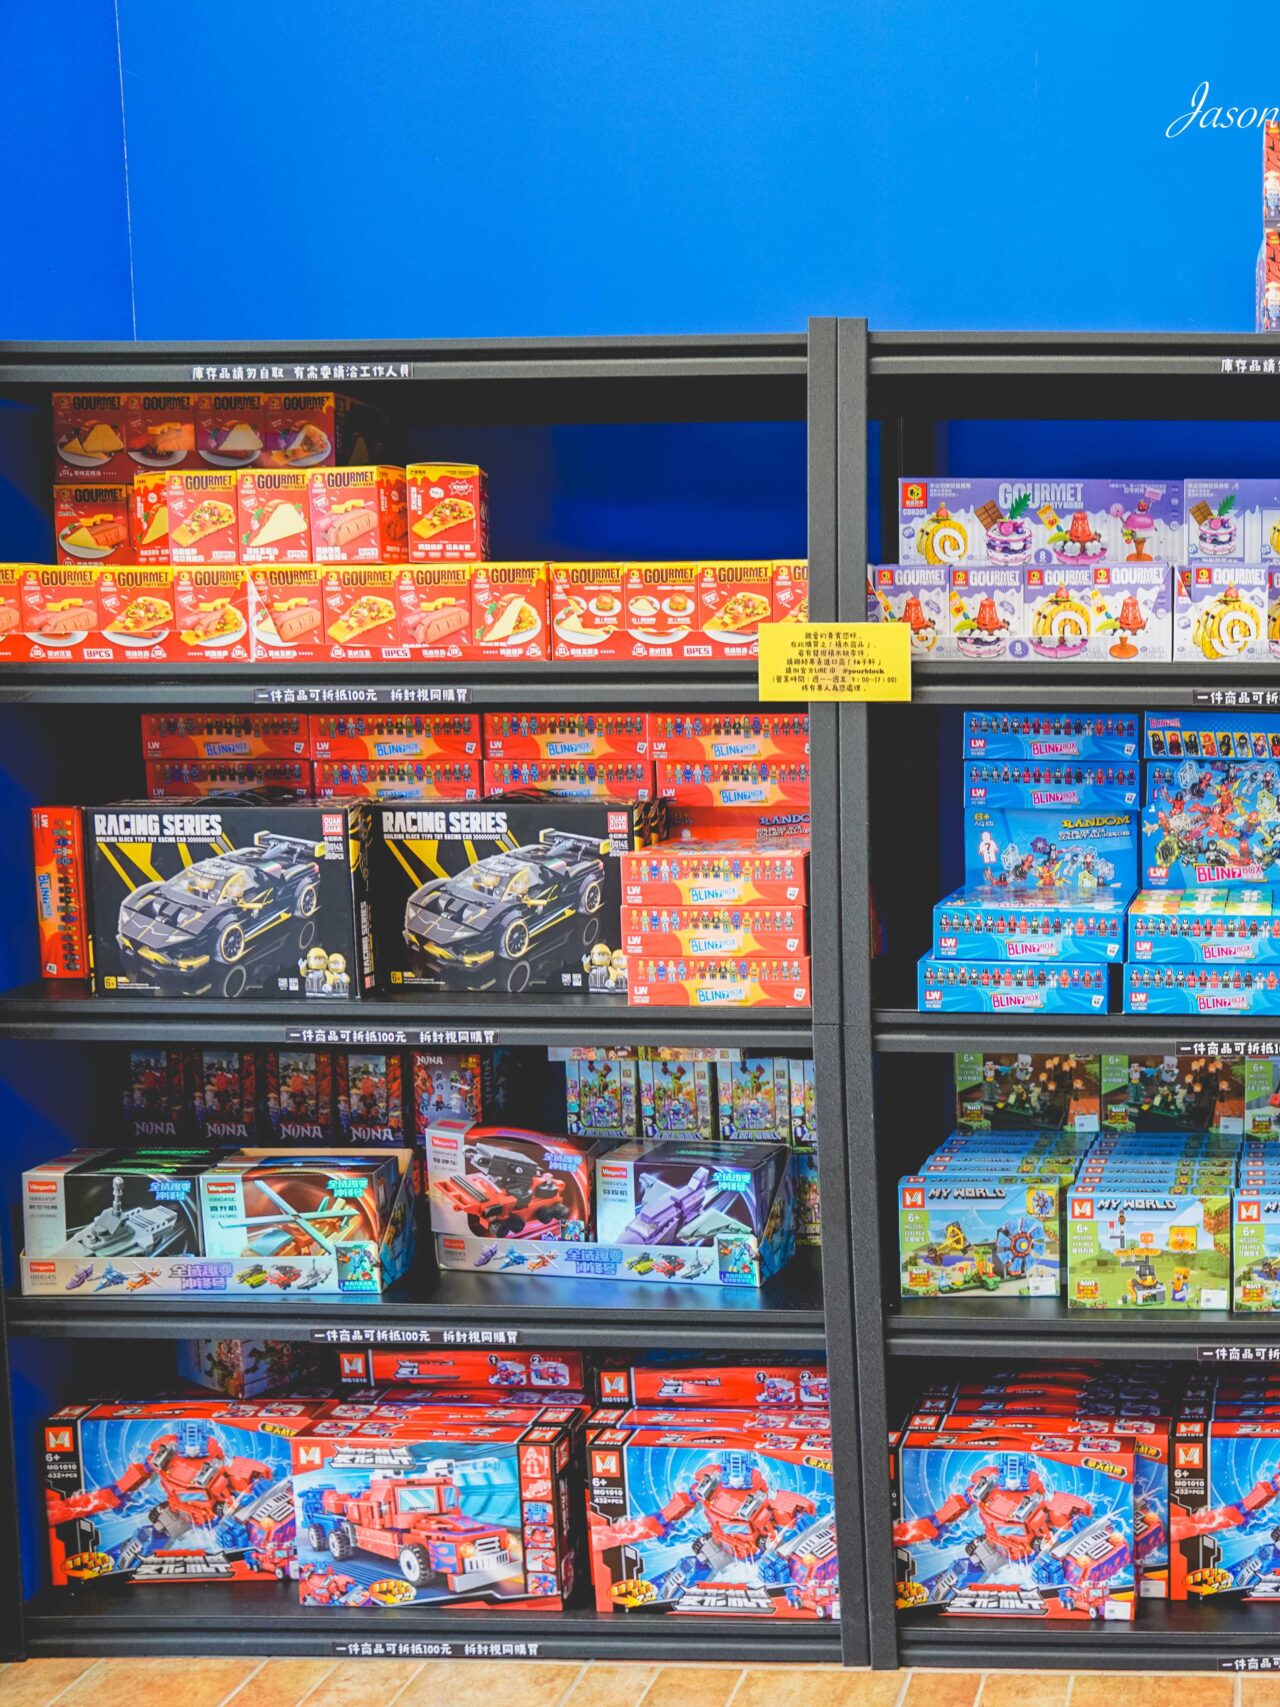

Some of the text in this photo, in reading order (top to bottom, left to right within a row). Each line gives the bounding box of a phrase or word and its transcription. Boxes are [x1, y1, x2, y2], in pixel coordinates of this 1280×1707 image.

[191, 364, 410, 380] 庫存品請勿自取 有需要請洽工作人員
[73, 396, 121, 410] GOURMET
[185, 475, 233, 490] GOURMET
[327, 472, 374, 488] GOURMET
[999, 484, 1083, 509] GOURMET
[41, 570, 93, 586] GOURMET
[118, 571, 169, 587] GOURMET
[342, 570, 392, 586] GOURMET
[571, 568, 621, 583] GOURMET
[718, 567, 768, 583] GOURMET
[970, 570, 1020, 586] GOURMET
[1112, 567, 1161, 585] GOURMET
[1213, 568, 1265, 586] GOURMET
[85, 650, 111, 658] 8PCS
[383, 649, 408, 657] 8PCS
[686, 647, 710, 655] 8PCS
[258, 689, 467, 702] 一件商品可折抵100元 拆封視同購買
[490, 741, 502, 749] LW
[971, 739, 984, 747] LW
[94, 814, 222, 836] RACING SERIES
[382, 812, 507, 833] RACING SERIES
[609, 814, 627, 823] QUAN
[1063, 815, 1130, 829] RANDOM
[1150, 868, 1166, 878] LW
[290, 1029, 494, 1044] 一件商品可折抵100元 拆封視同購買
[928, 1187, 1008, 1199] MY WORLD
[1097, 1199, 1177, 1211] MY WORLD
[1076, 1225, 1089, 1233] 6+
[314, 1330, 517, 1343] 一件商品可折抵100元 拆封視同購買
[45, 1454, 60, 1462] 6+
[335, 1643, 538, 1655] 一件商品可折抵100元 拆封視同購買
